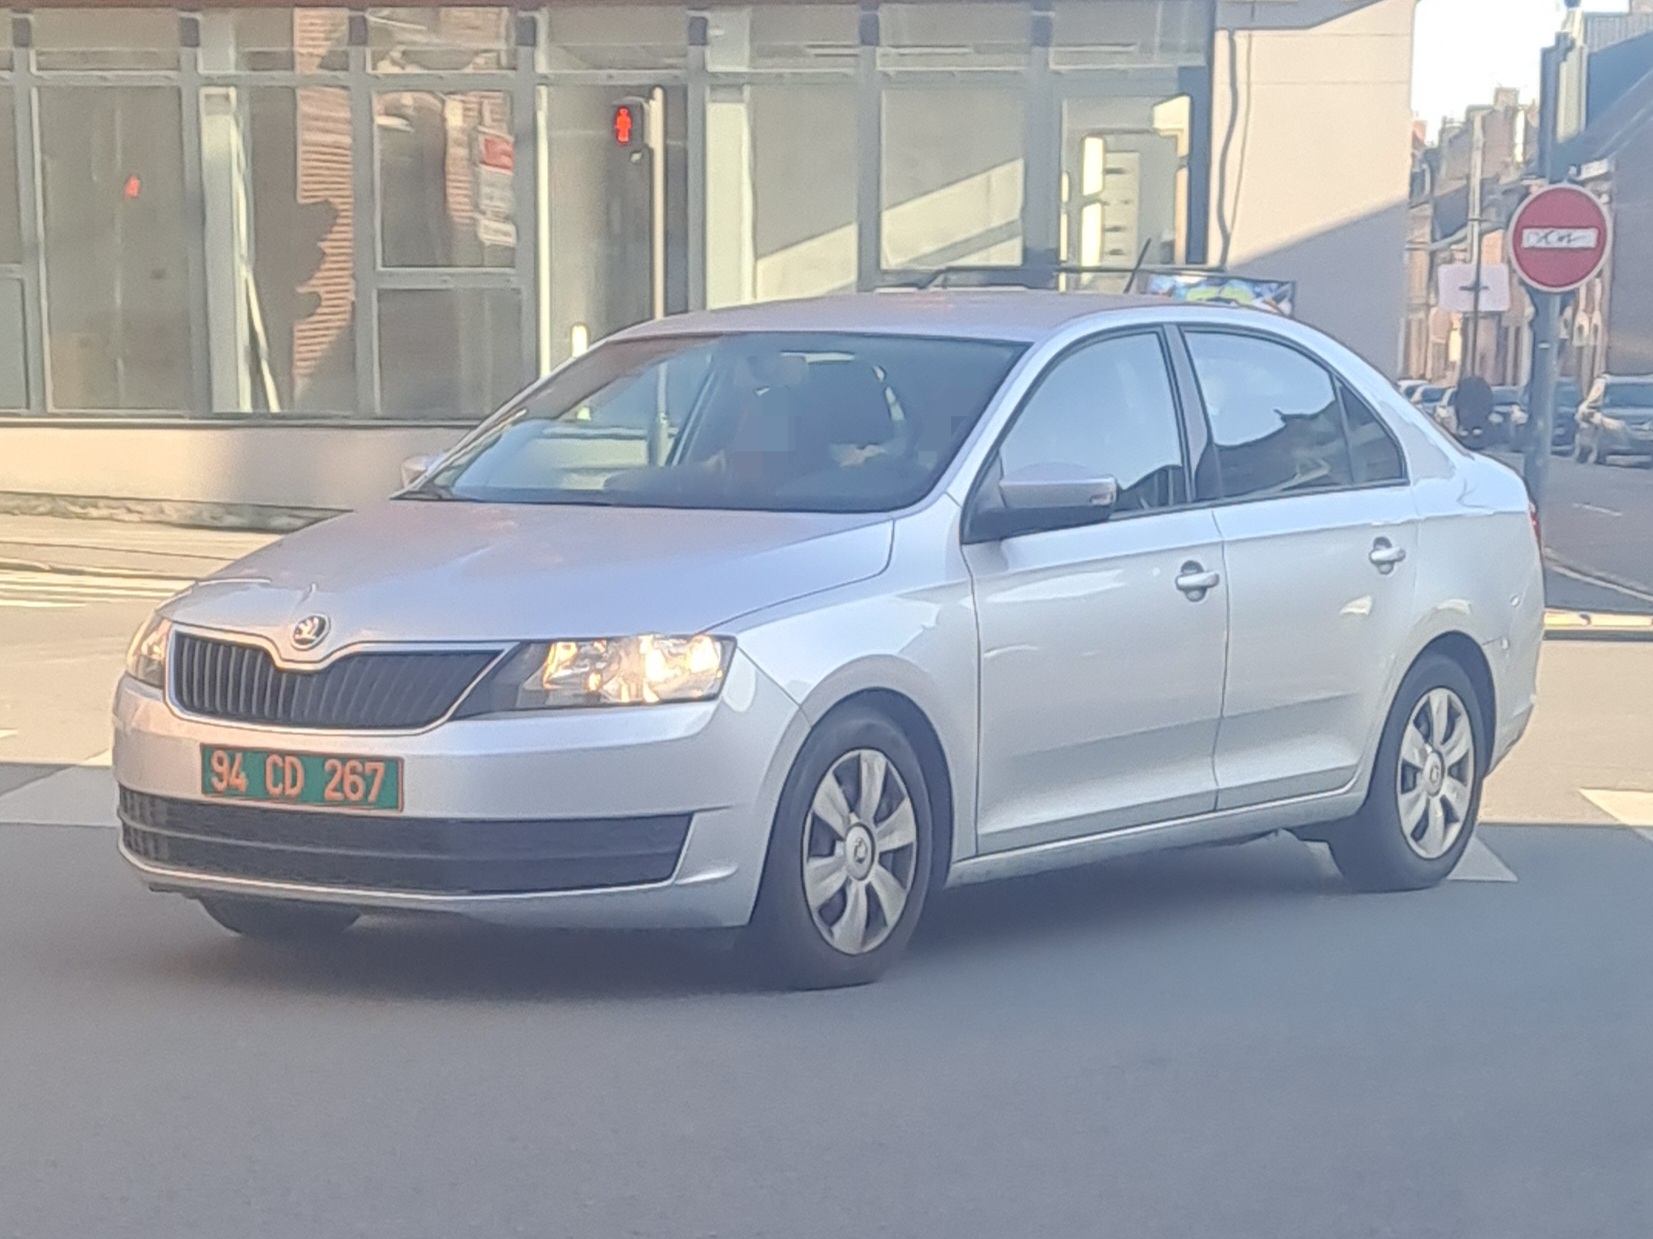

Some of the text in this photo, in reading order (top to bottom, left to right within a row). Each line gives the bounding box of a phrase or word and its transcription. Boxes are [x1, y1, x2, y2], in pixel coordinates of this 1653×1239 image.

[211, 750, 385, 802] 94 CD 267
